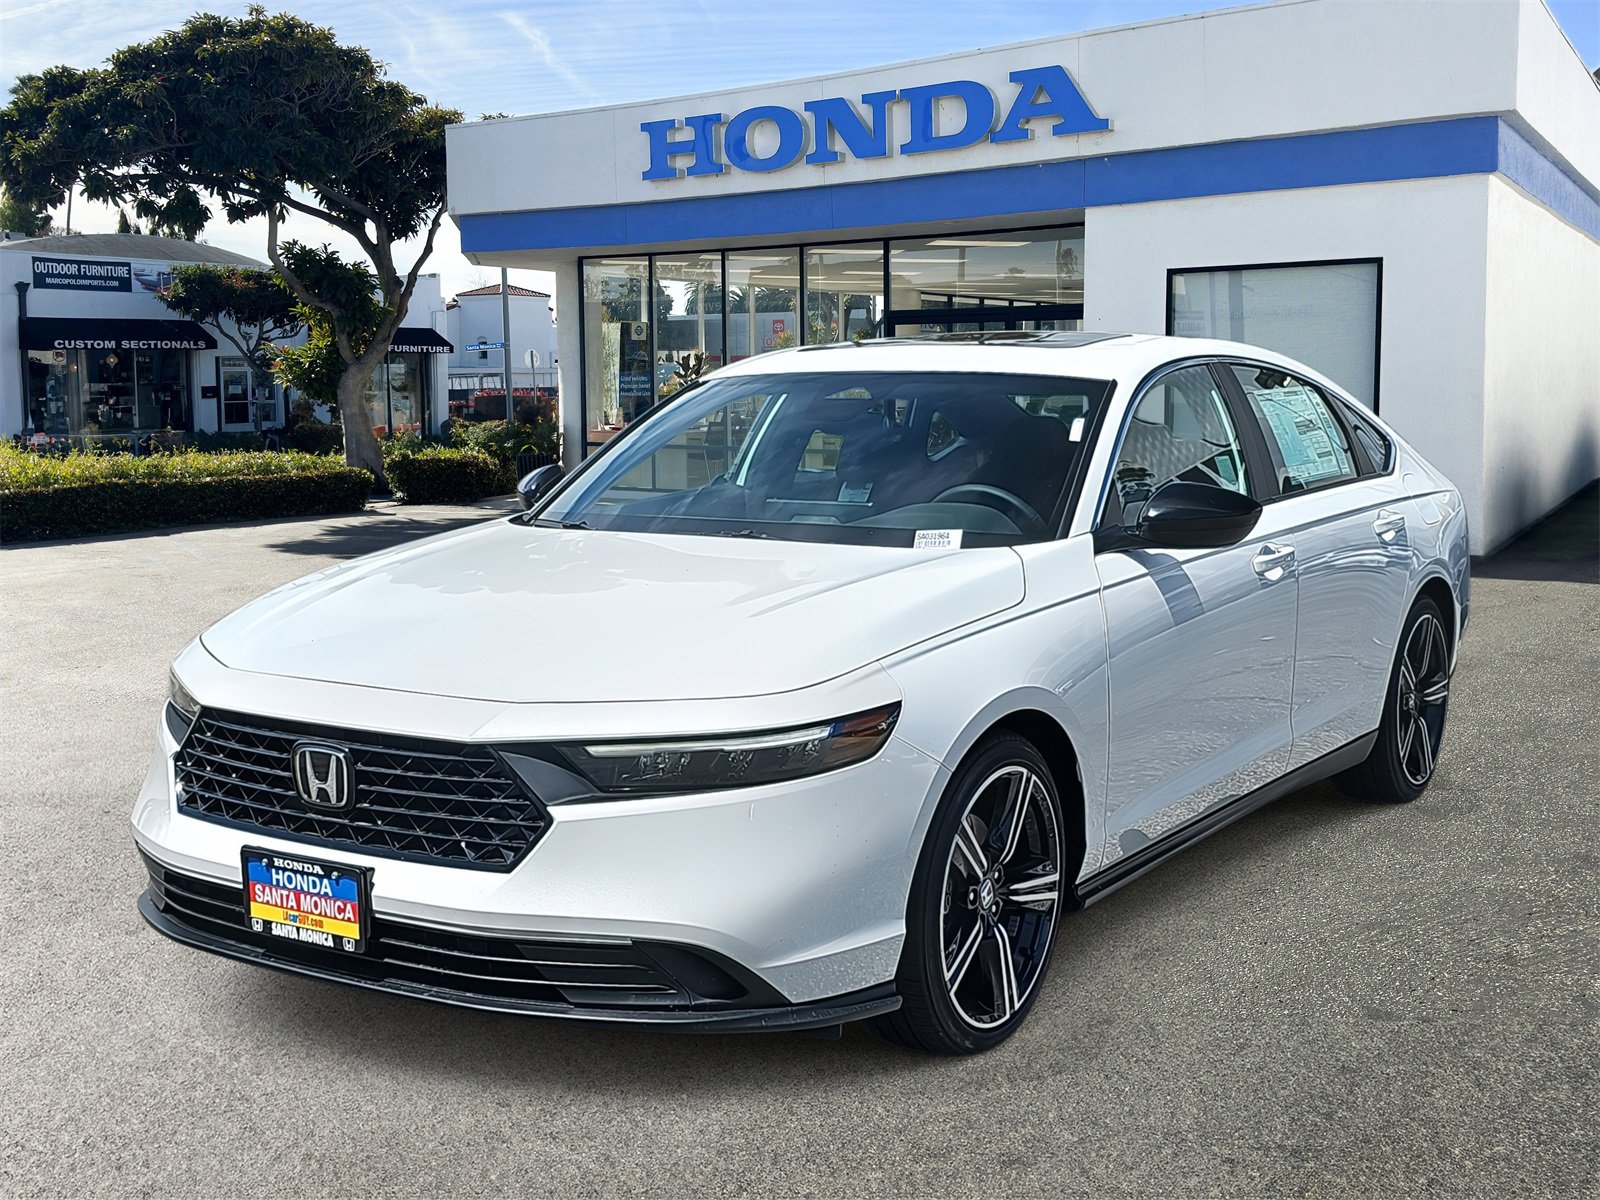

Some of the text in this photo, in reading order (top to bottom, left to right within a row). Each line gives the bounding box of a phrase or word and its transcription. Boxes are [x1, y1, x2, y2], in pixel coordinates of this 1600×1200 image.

[640, 65, 1110, 181] HONDA
[34, 261, 129, 278] OUTDOOR FURNITURE
[45, 277, 118, 287] MARCOPOLOIMPORTS.COM
[54, 339, 207, 350] CUSTOM SECTIONALS
[388, 344, 450, 353] FURNITURE
[273, 857, 324, 875] HONDA
[271, 868, 333, 896] HONDA
[255, 885, 354, 921] SANTA MONICA
[272, 922, 334, 947] SANTA MONICA
